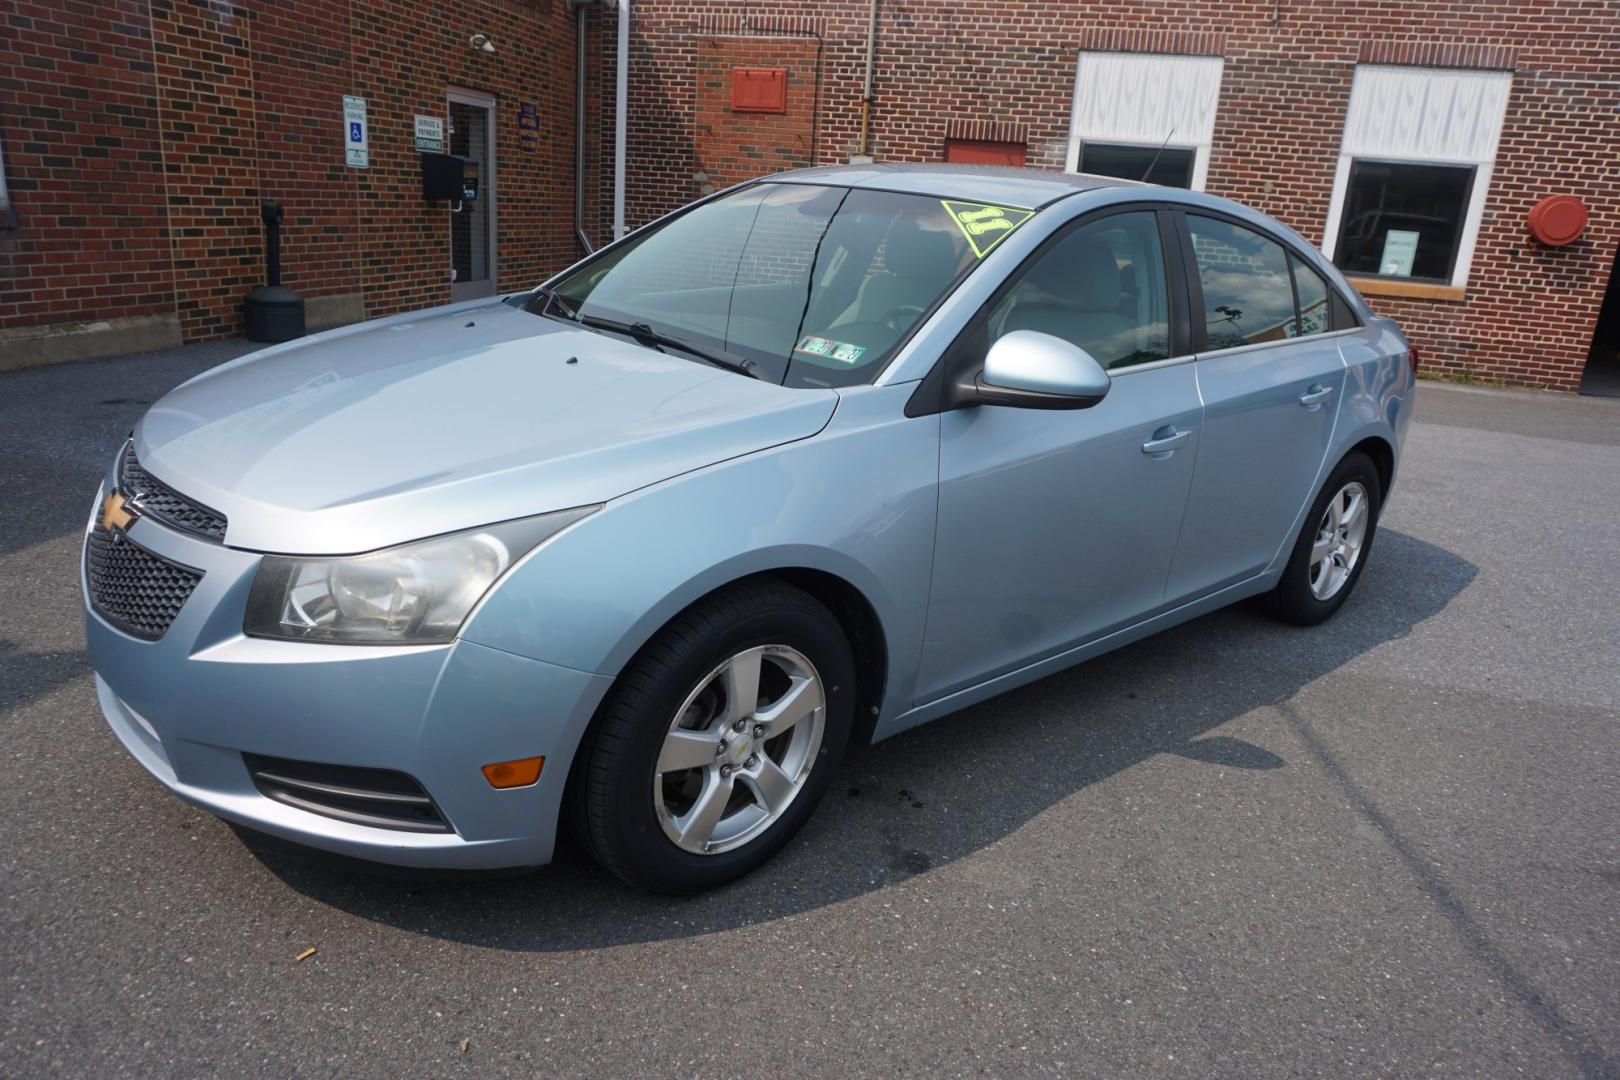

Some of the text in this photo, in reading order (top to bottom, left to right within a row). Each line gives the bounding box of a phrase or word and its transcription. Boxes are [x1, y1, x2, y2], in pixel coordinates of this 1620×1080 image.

[417, 119, 436, 128] SERVICE
[417, 128, 441, 137] PAYMENTS
[417, 138, 443, 150] ENTRANCE
